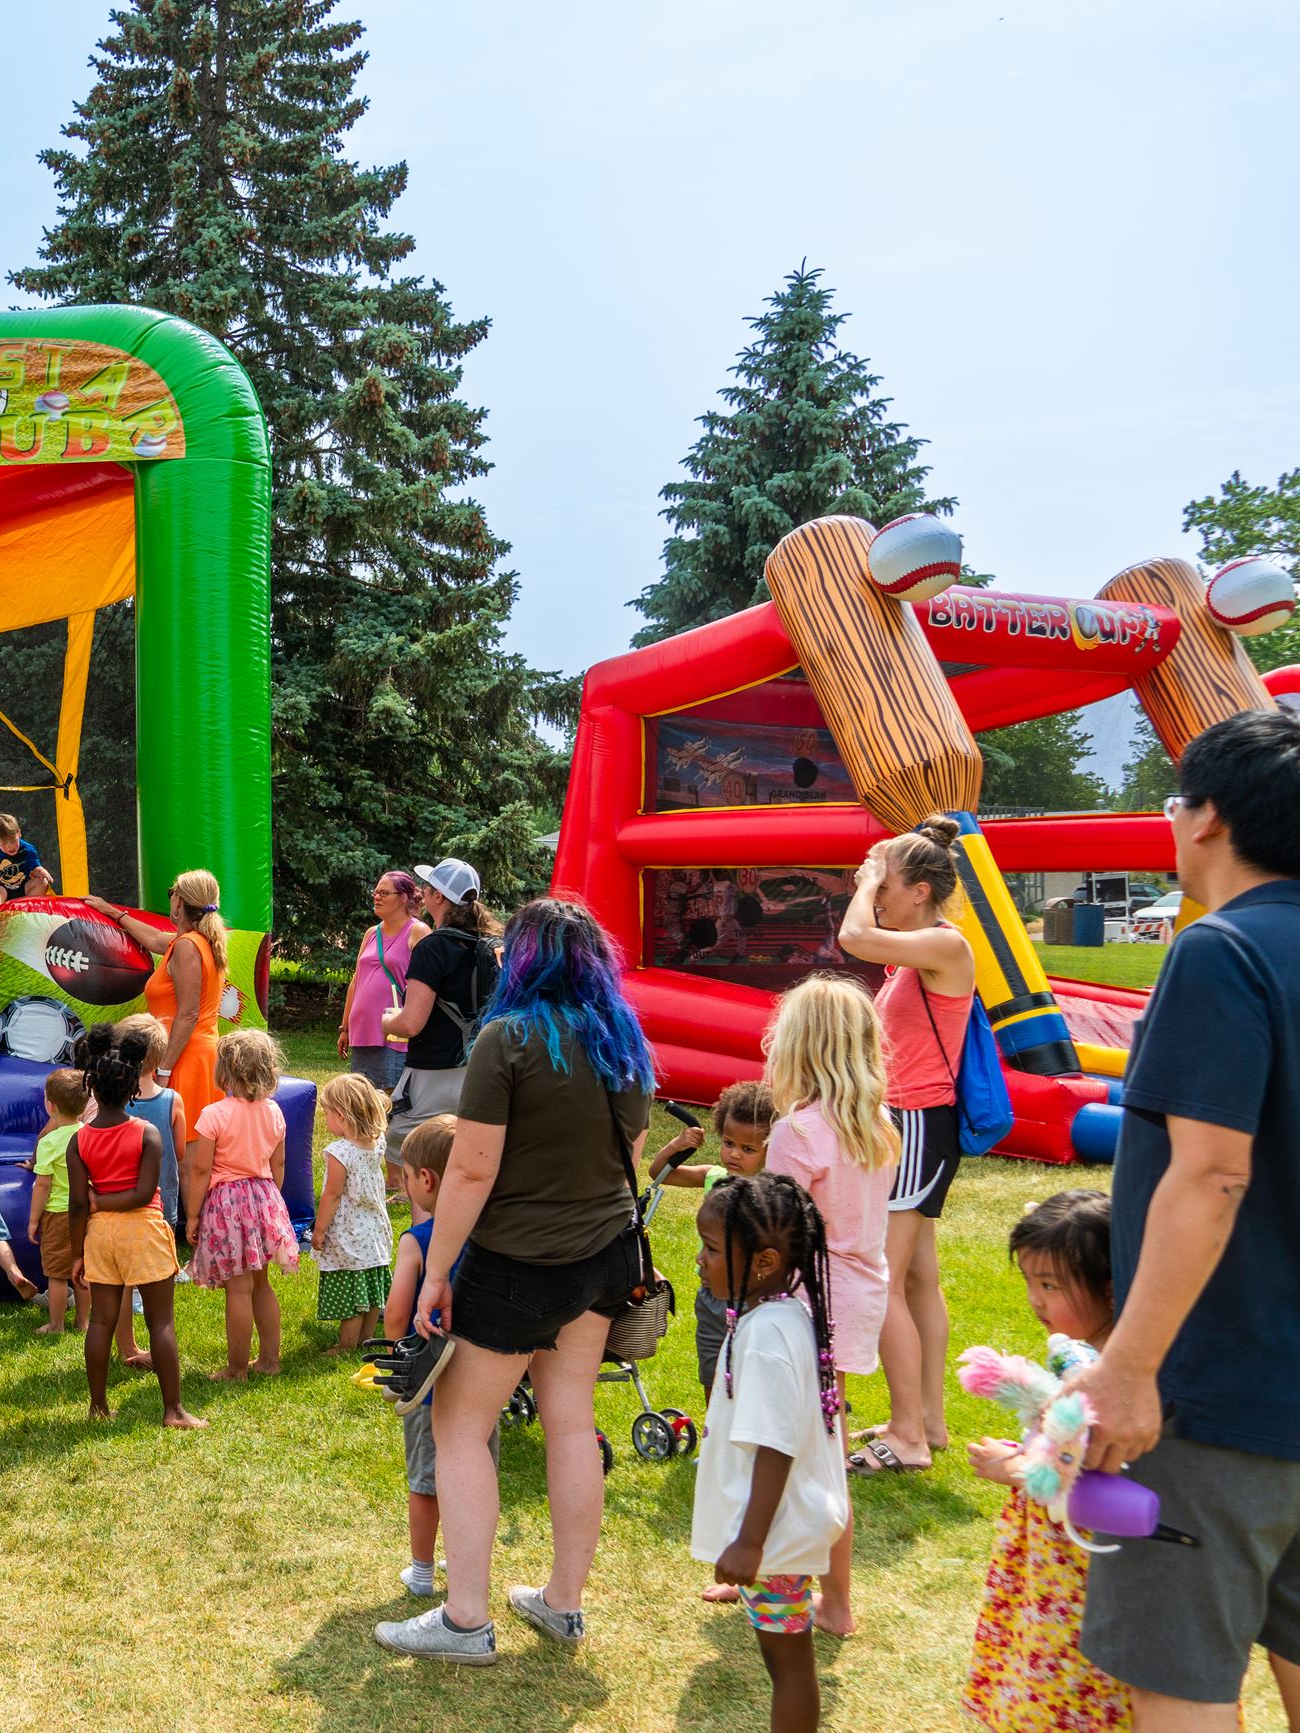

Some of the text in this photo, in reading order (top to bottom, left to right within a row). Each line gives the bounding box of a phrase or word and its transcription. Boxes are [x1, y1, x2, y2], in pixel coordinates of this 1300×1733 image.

[928, 592, 1071, 640] BATTER
[723, 780, 742, 799] 40
[770, 789, 800, 799] GRAND
[740, 868, 757, 885] 30
